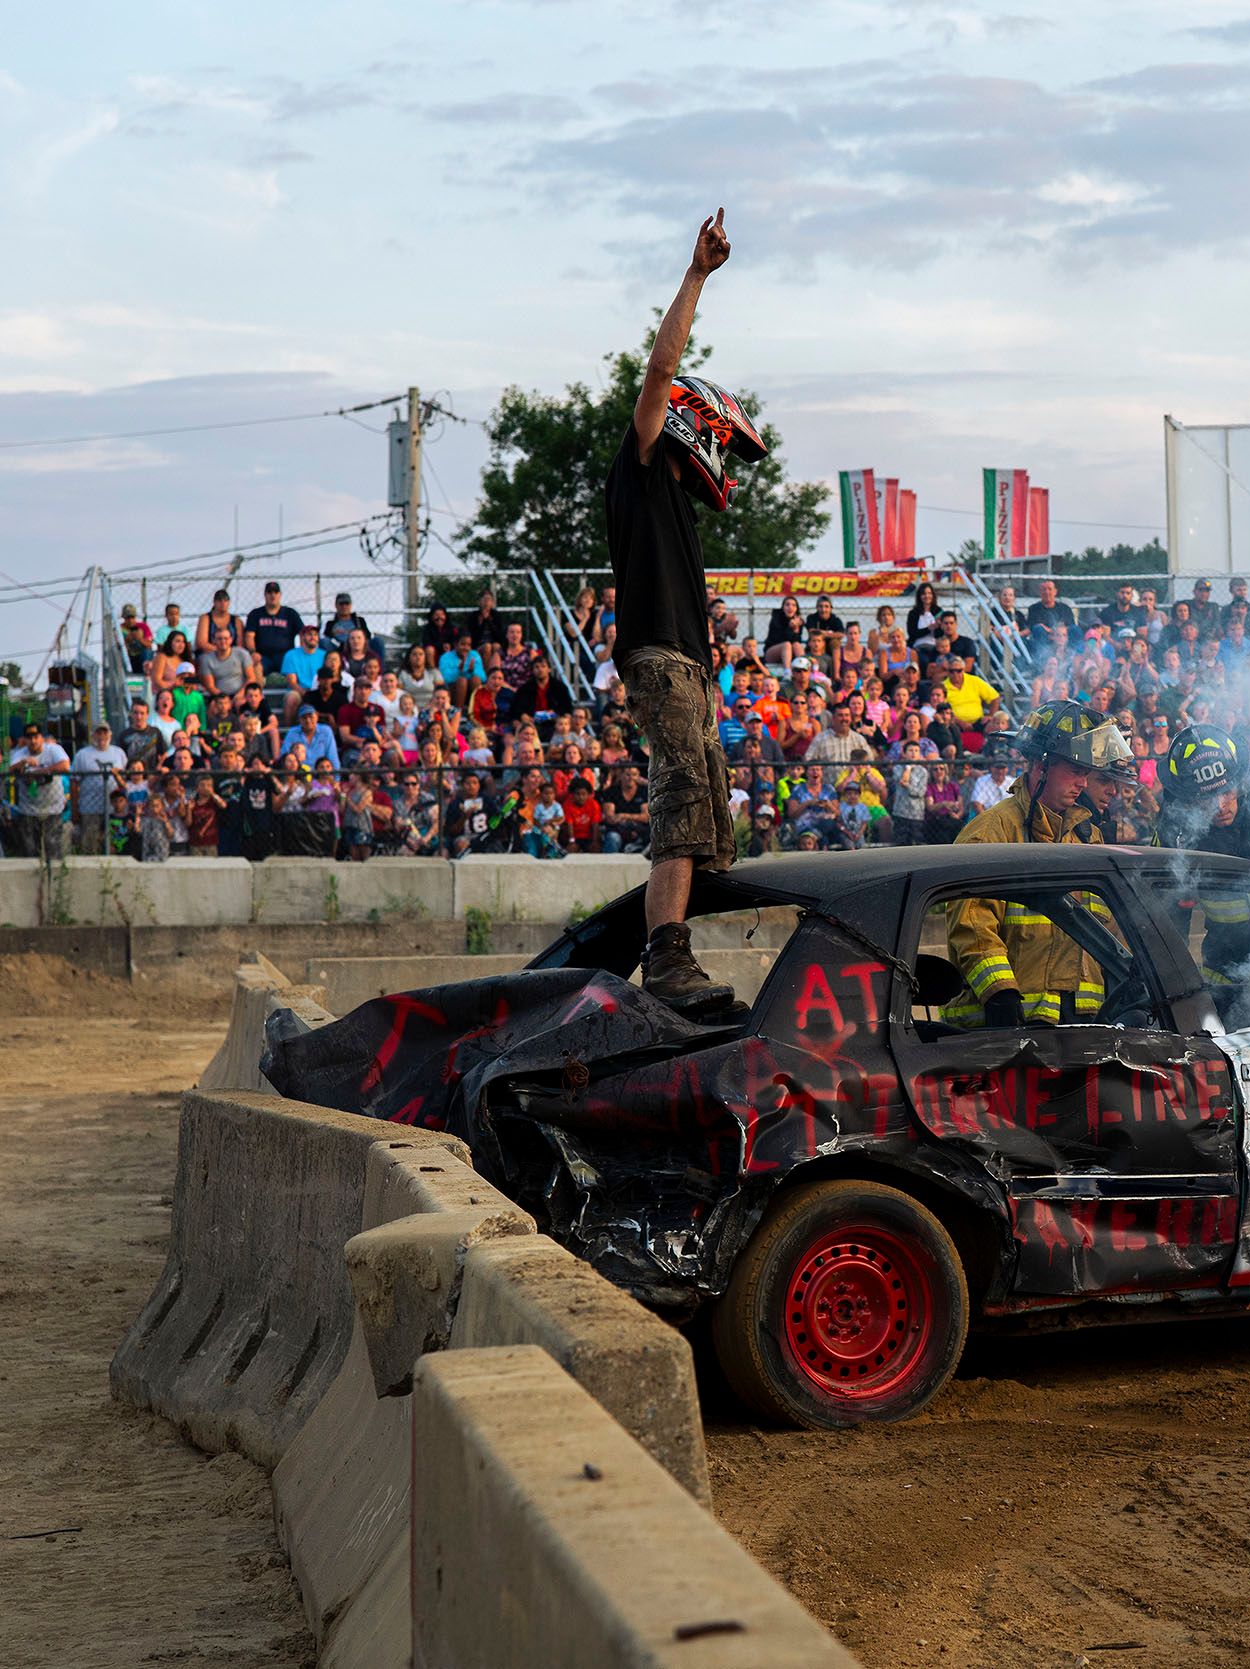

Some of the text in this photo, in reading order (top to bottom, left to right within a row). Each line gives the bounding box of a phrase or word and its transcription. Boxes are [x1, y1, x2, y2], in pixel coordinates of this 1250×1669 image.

[670, 420, 696, 440] HJC
[679, 390, 732, 440] 100%
[853, 482, 869, 561] PIZZA
[998, 482, 1009, 560] PIZZA
[705, 575, 858, 594] FRESH FOOD
[1193, 760, 1227, 785] 100
[796, 962, 887, 1034] AT
[1085, 1060, 1234, 1126] LINE
